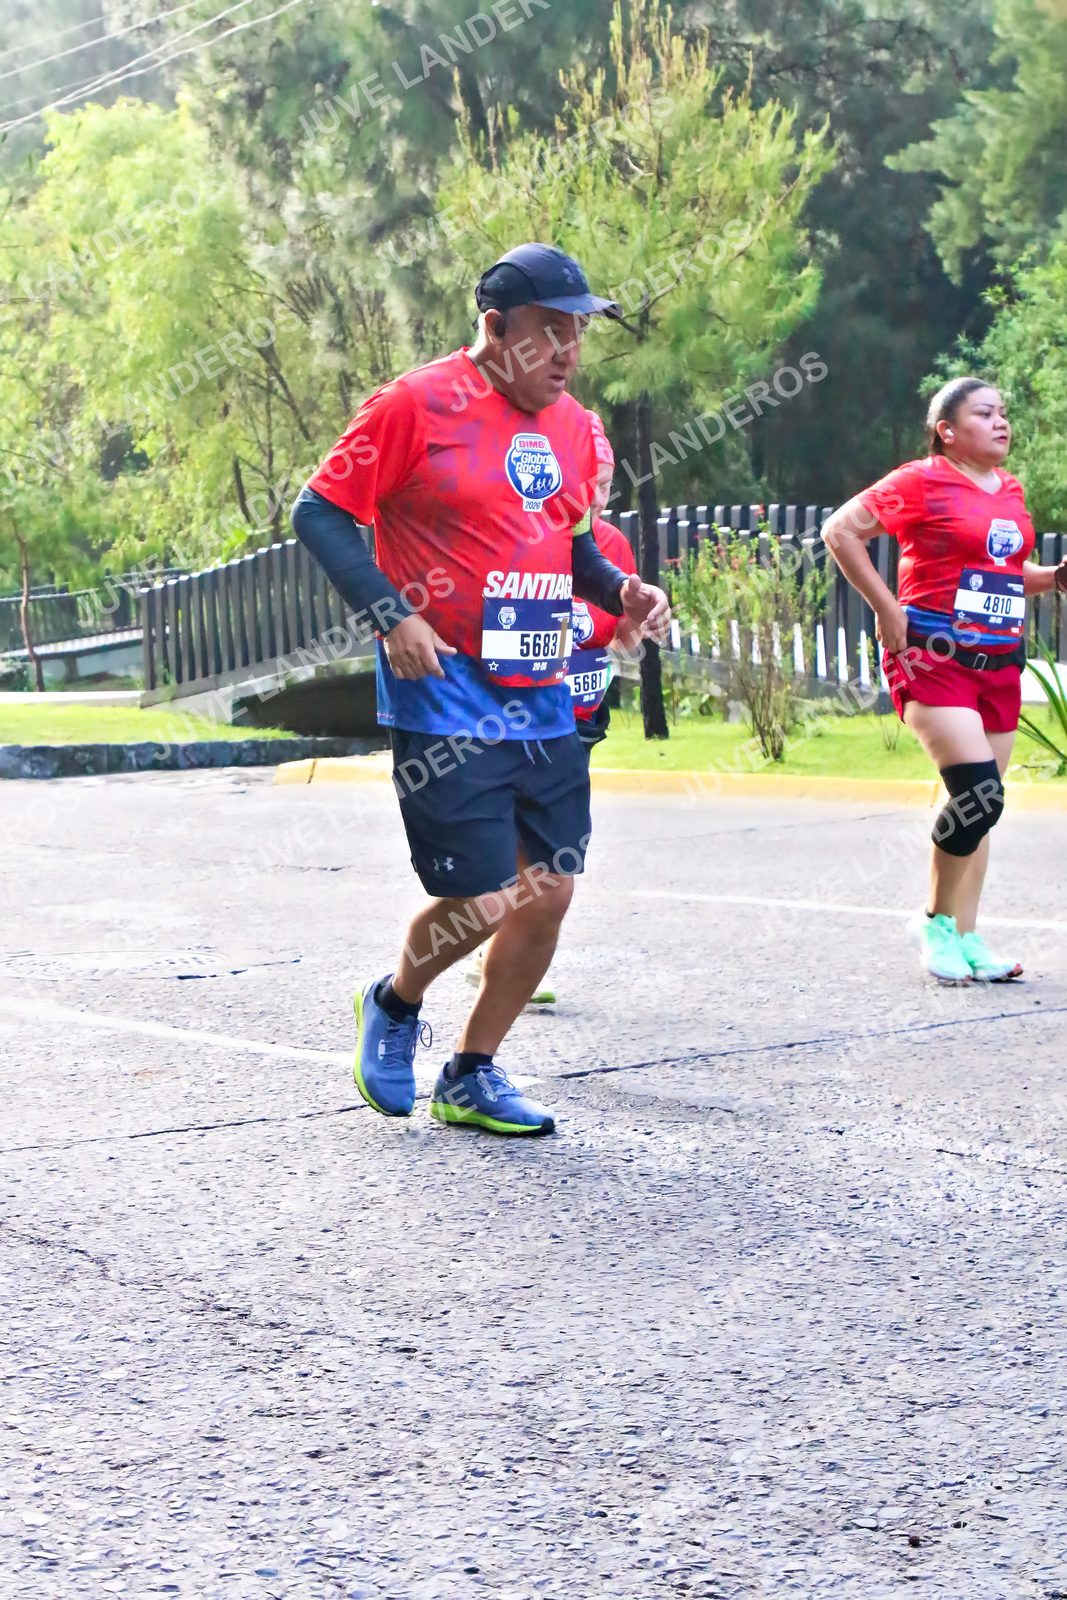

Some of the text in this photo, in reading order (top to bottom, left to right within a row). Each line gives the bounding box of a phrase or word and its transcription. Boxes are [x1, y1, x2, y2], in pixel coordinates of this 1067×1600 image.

[515, 462, 542, 475] Race
[483, 570, 573, 600] SANTIAG
[983, 595, 1012, 615] 4810
[520, 633, 558, 657] 5683
[574, 672, 603, 693] 5681
